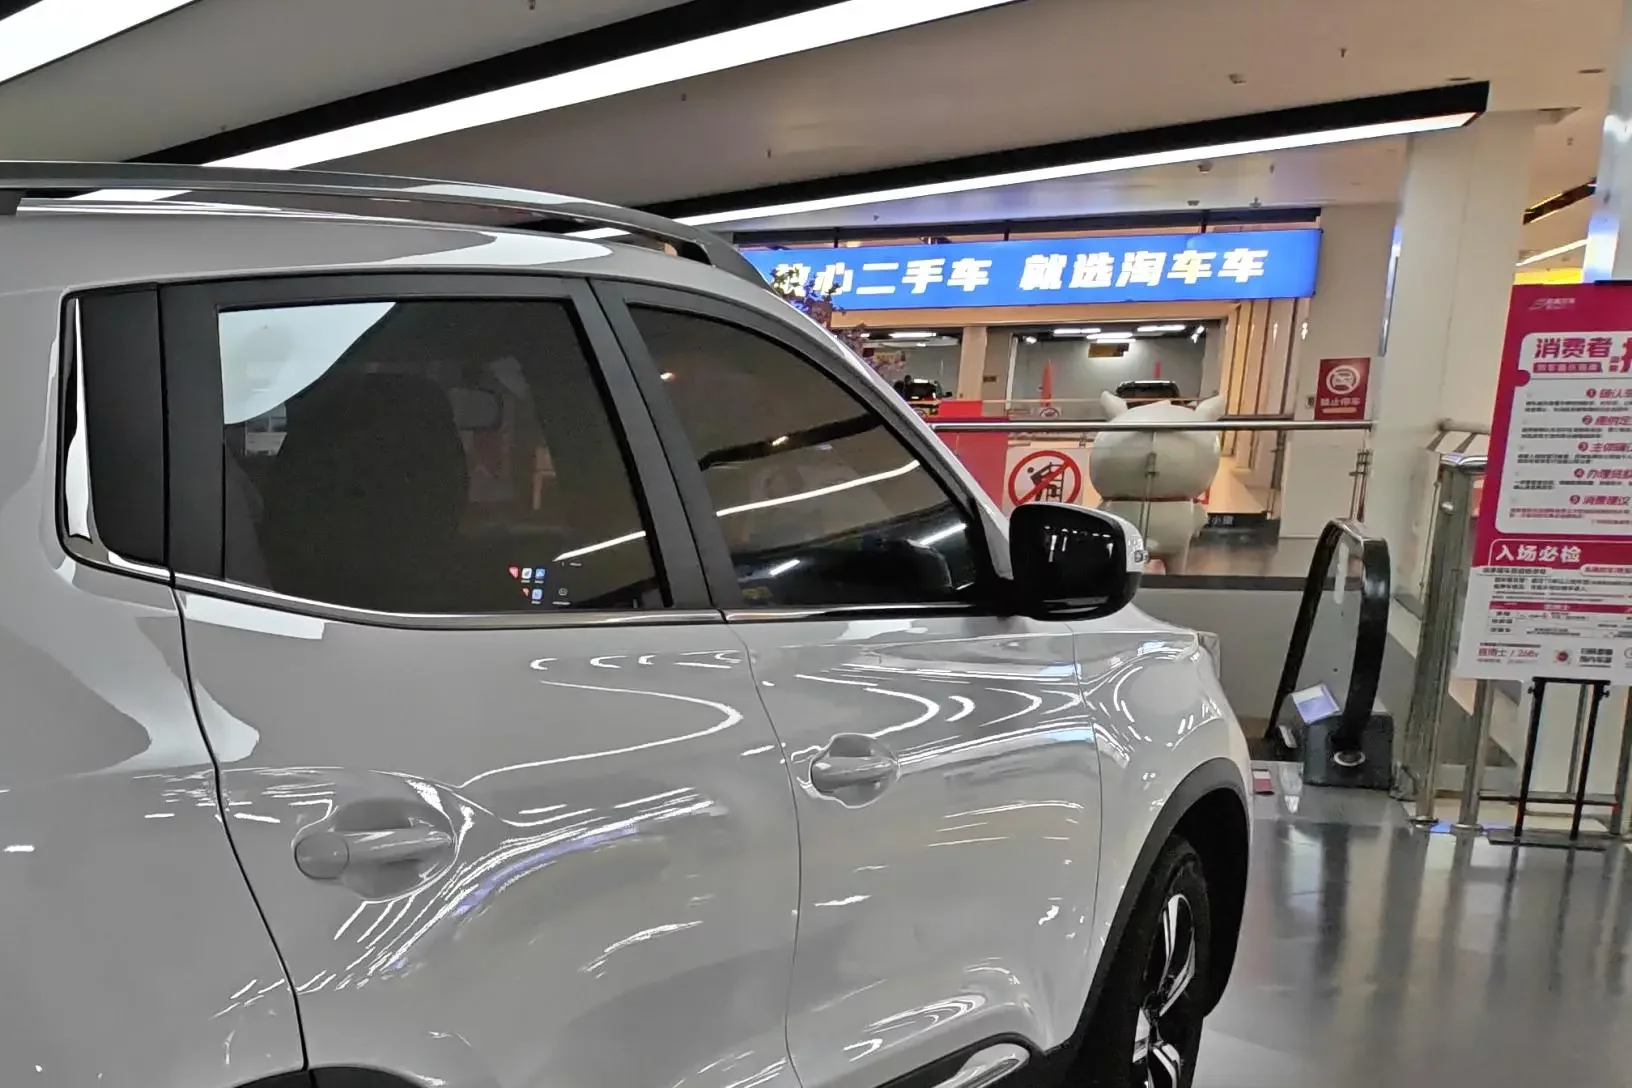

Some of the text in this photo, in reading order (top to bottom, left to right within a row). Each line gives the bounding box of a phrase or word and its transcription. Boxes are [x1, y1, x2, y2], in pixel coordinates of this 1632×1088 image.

[1018, 247, 1269, 291] 就选淘车车
[1534, 337, 1613, 359] 消费者
[1495, 544, 1581, 563] 入场必检
